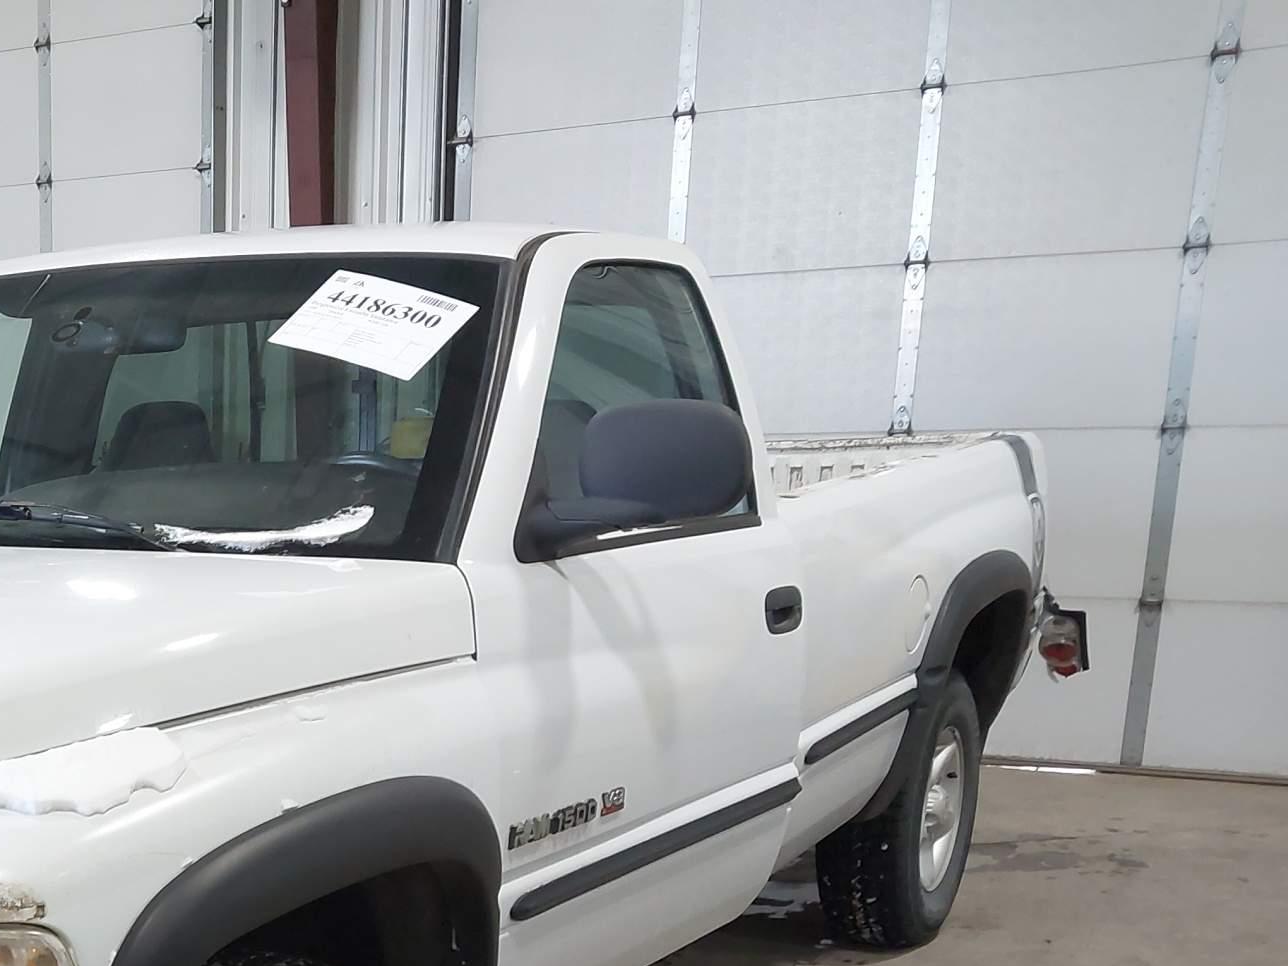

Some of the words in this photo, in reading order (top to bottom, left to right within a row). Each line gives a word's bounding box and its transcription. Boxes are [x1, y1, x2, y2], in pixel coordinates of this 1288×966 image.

[326, 290, 443, 330] 44186300
[508, 813, 552, 850] RAM
[551, 798, 598, 834] 1500
[600, 786, 626, 811] V8
